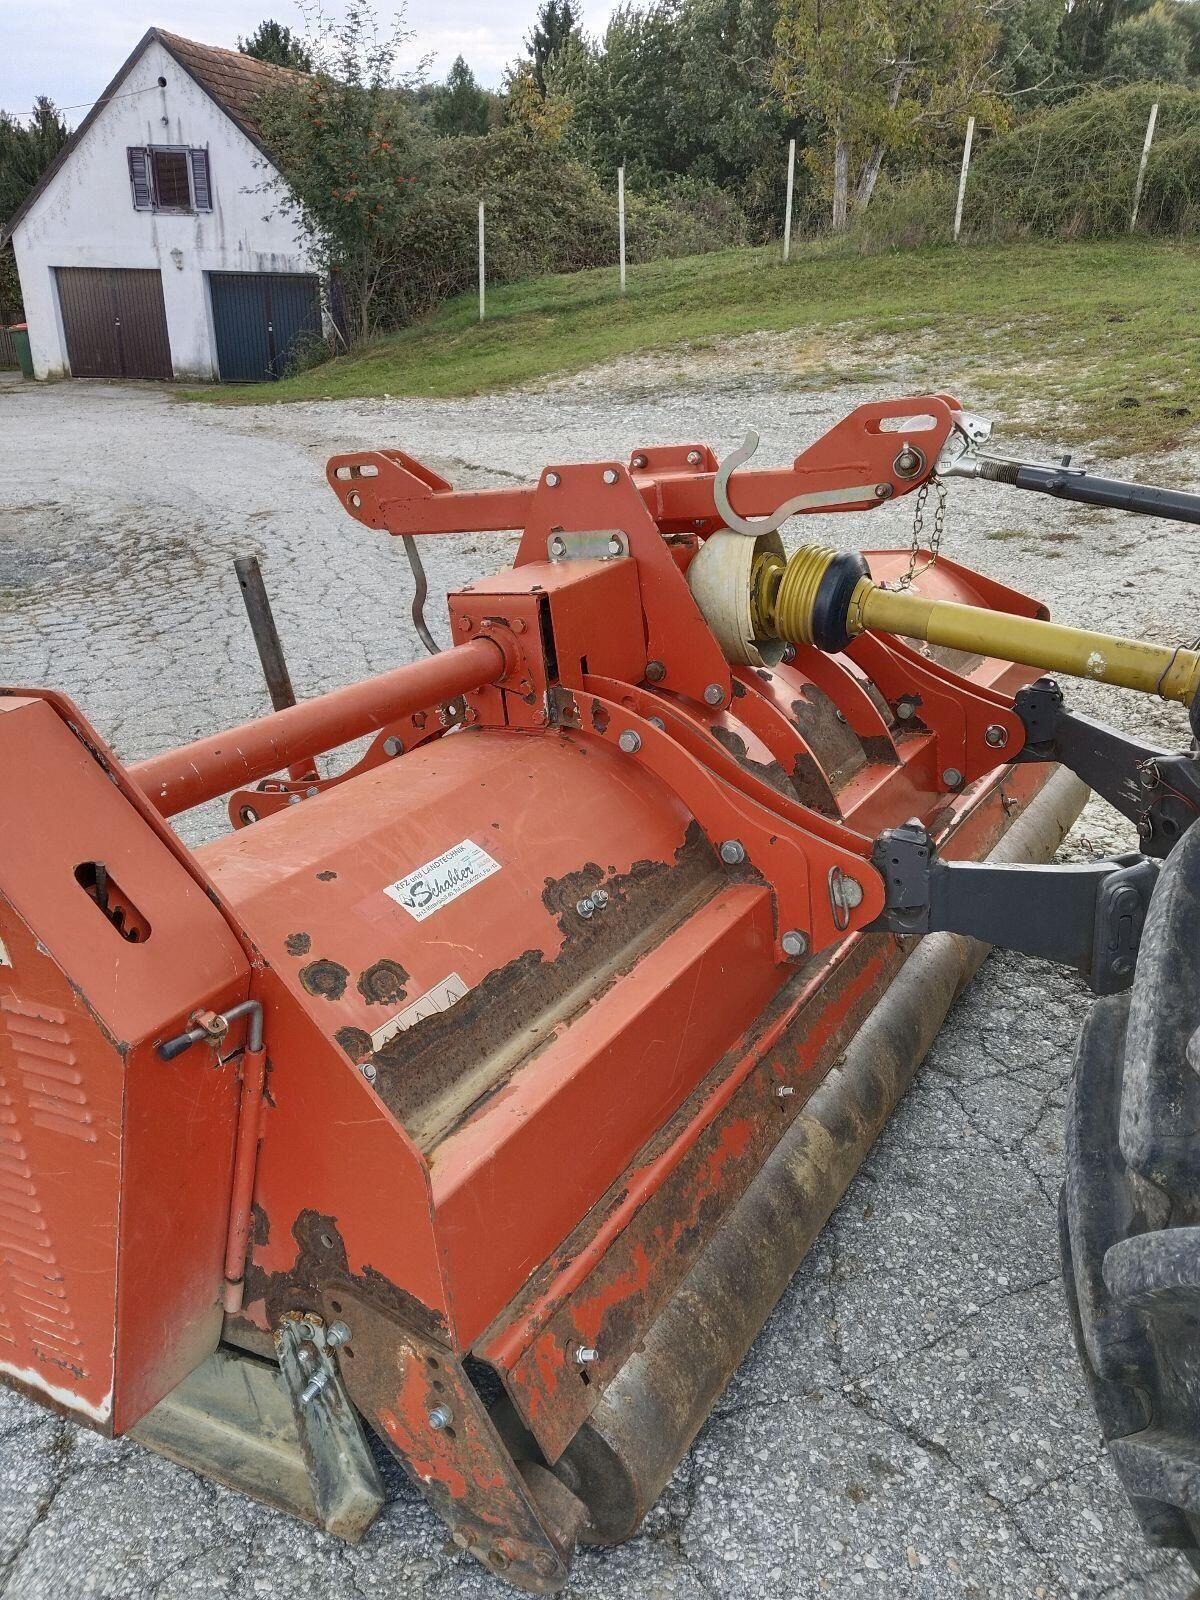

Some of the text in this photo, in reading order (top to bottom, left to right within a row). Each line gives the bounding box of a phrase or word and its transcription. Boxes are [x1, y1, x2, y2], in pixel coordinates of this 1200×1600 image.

[394, 880, 410, 892] KFZ
[410, 872, 423, 883] und
[421, 845, 467, 875] LANDTECHNIK
